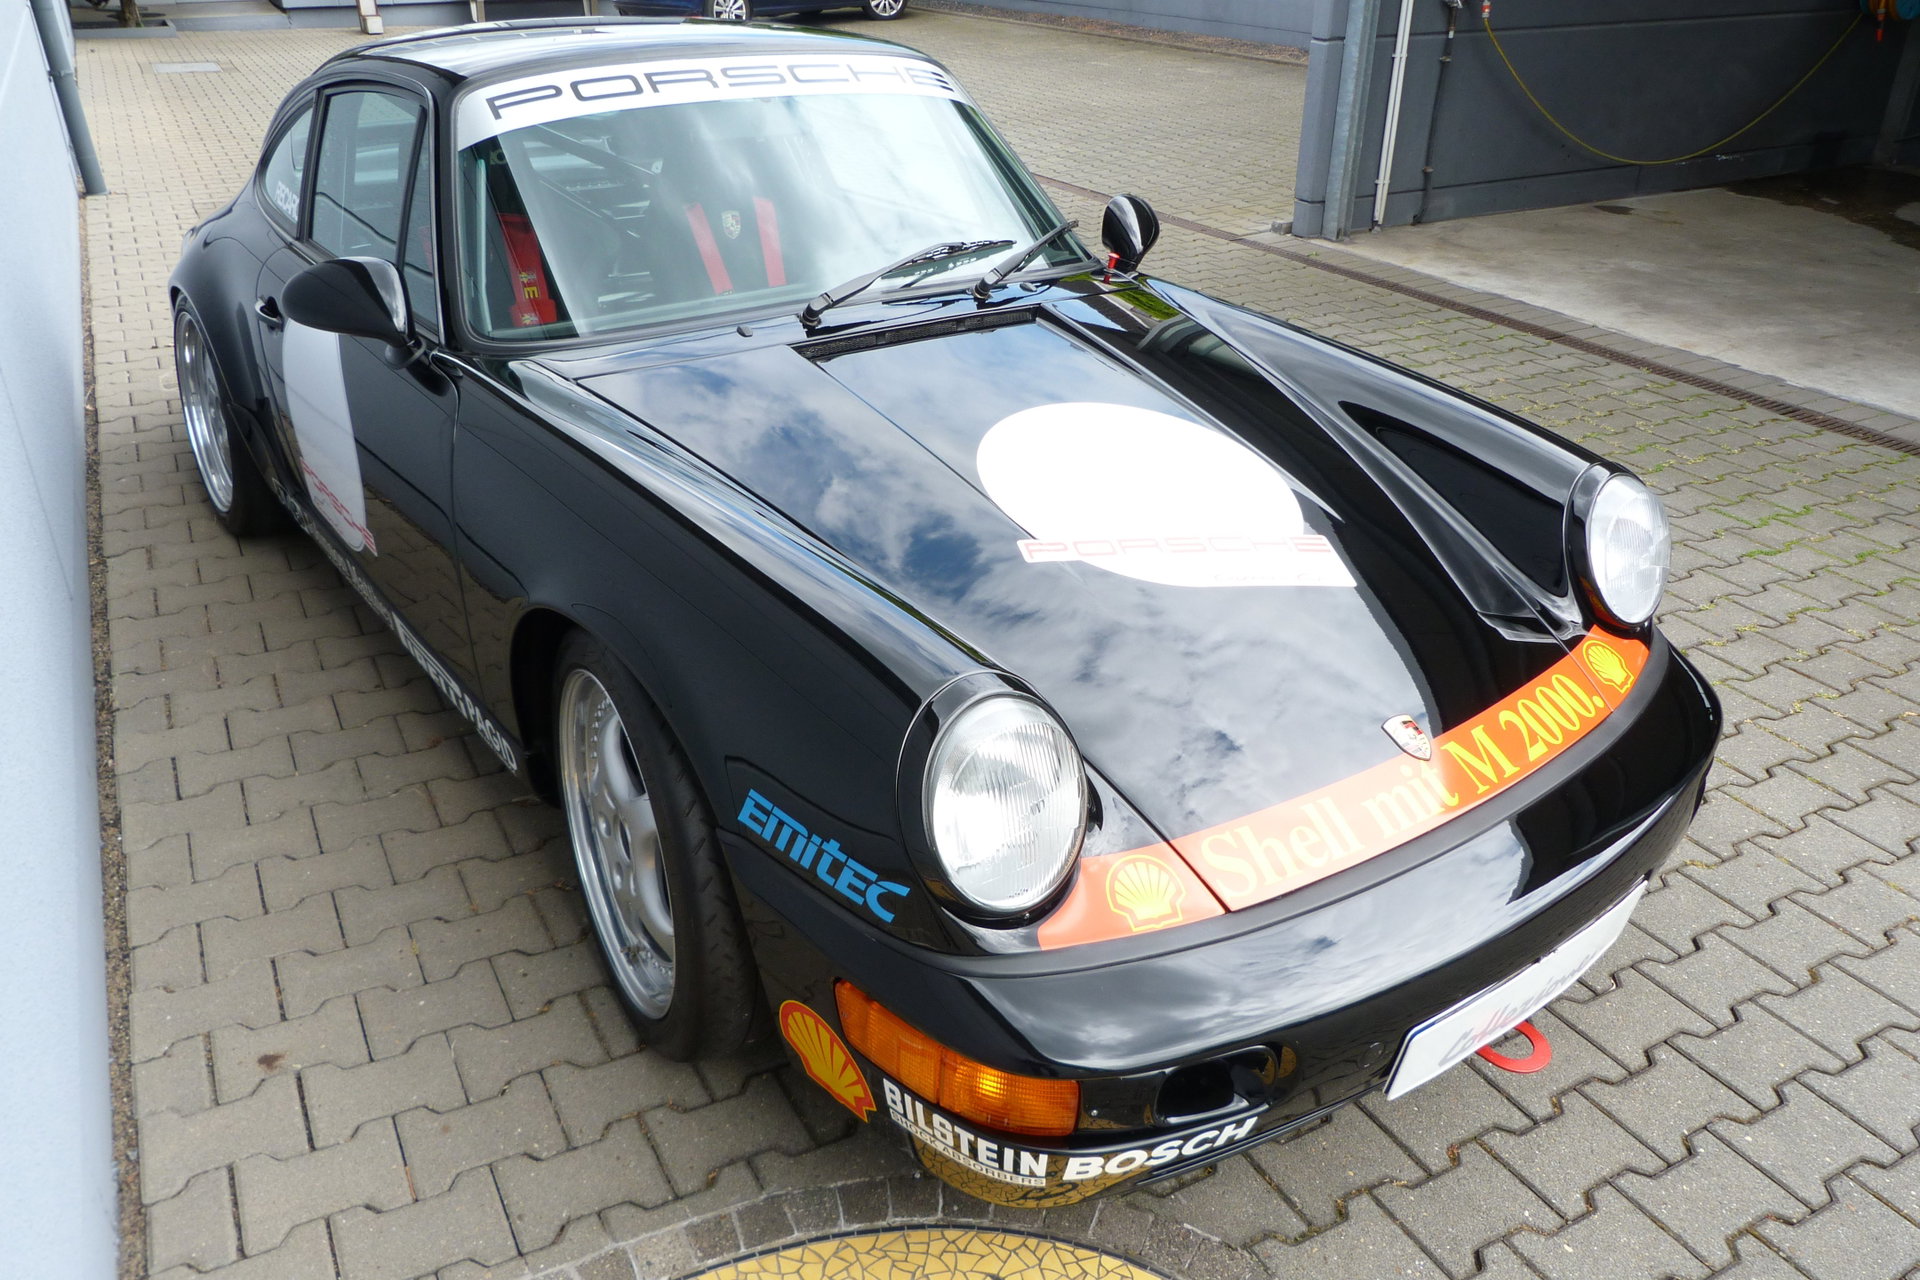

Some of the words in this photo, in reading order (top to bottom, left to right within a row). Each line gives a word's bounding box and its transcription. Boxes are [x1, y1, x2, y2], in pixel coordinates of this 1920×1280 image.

[485, 64, 955, 120] PORSCHE
[274, 181, 300, 221] RECAR
[1023, 536, 1331, 560] PORSCHE
[1199, 796, 1363, 900] Shell
[1364, 760, 1462, 834] mit
[1440, 722, 1522, 796] M
[1498, 671, 1607, 763] 2000.
[883, 1078, 1049, 1178] BILSTEIN
[891, 1111, 938, 1147] SHOCK
[941, 1144, 1047, 1186] ABSORBERS
[1062, 1116, 1258, 1182] BOSCH
